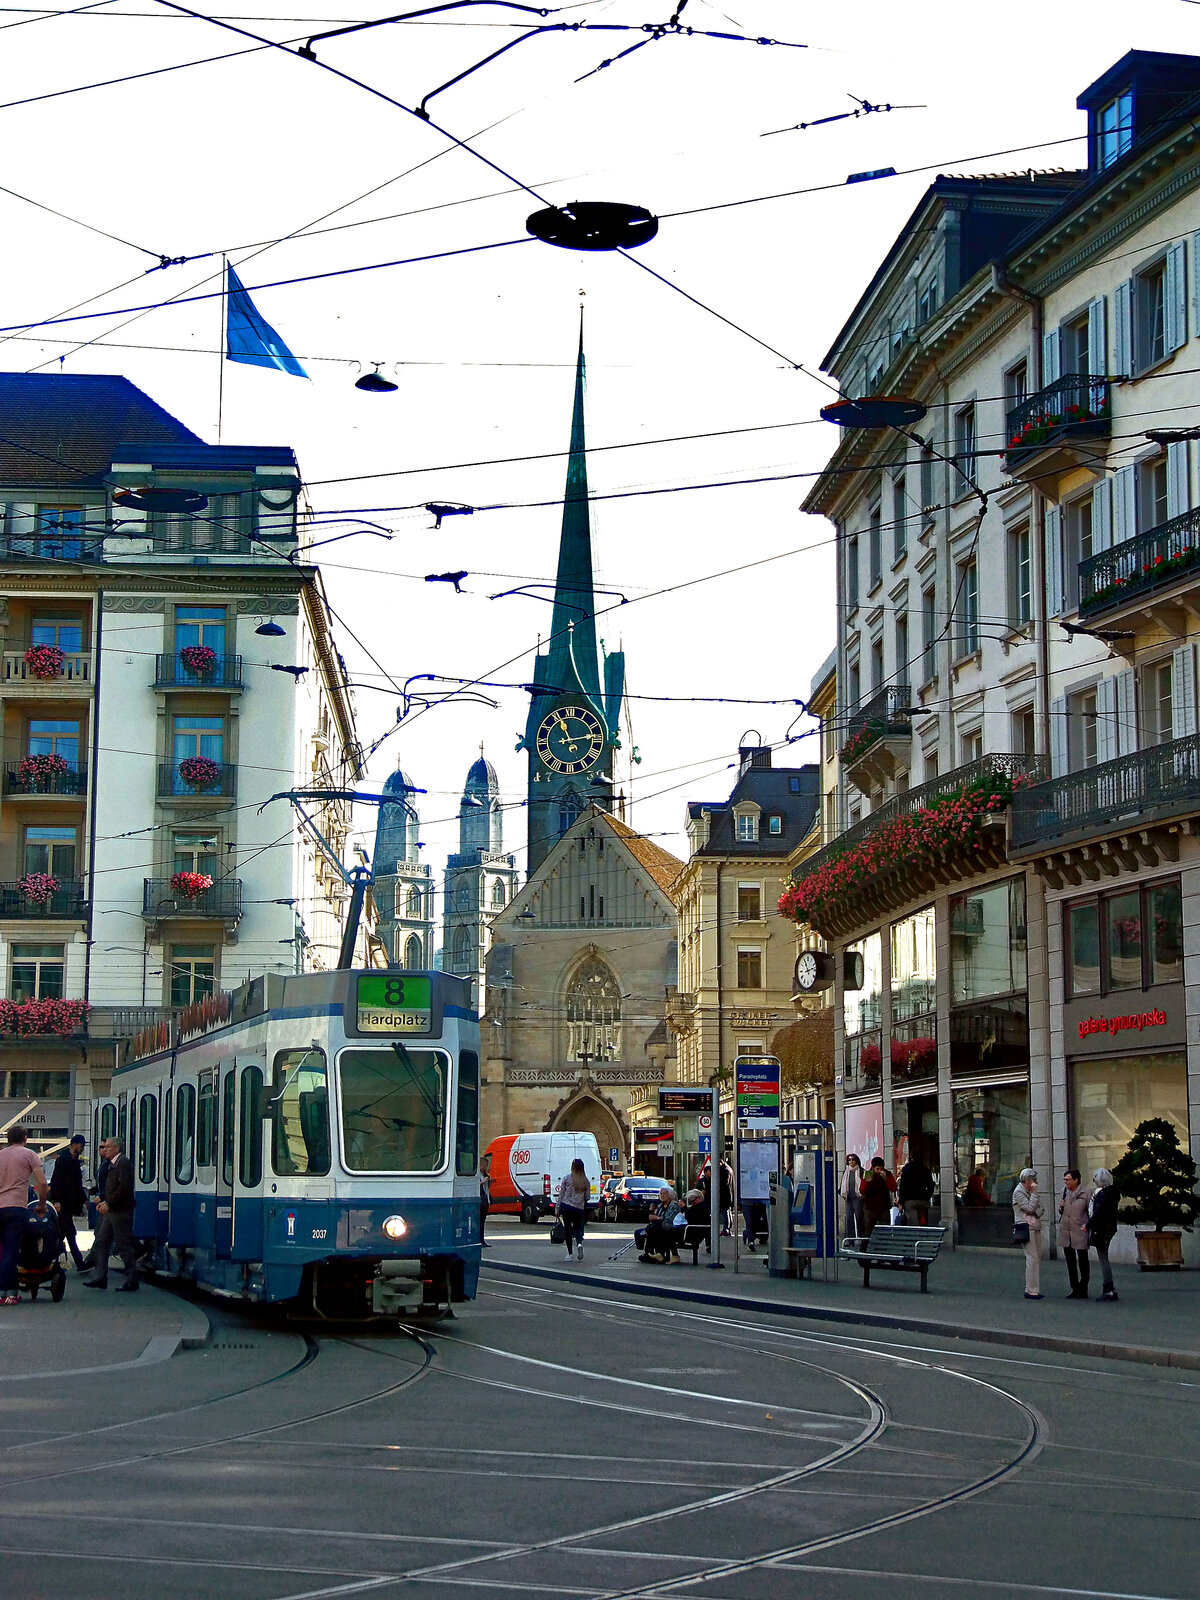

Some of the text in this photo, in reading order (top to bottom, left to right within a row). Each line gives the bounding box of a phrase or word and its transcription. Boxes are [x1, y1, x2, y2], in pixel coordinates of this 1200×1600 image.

[384, 978, 405, 1006] 8
[361, 1013, 427, 1028] Hardplatz
[1078, 1007, 1167, 1039] galerie gmurzynska
[743, 1084, 749, 1092] 2
[742, 1095, 749, 1104] 8
[742, 1108, 749, 1116] 9
[611, 1148, 617, 1156] P
[512, 1150, 531, 1165] TNT
[312, 1229, 327, 1239] 2037
